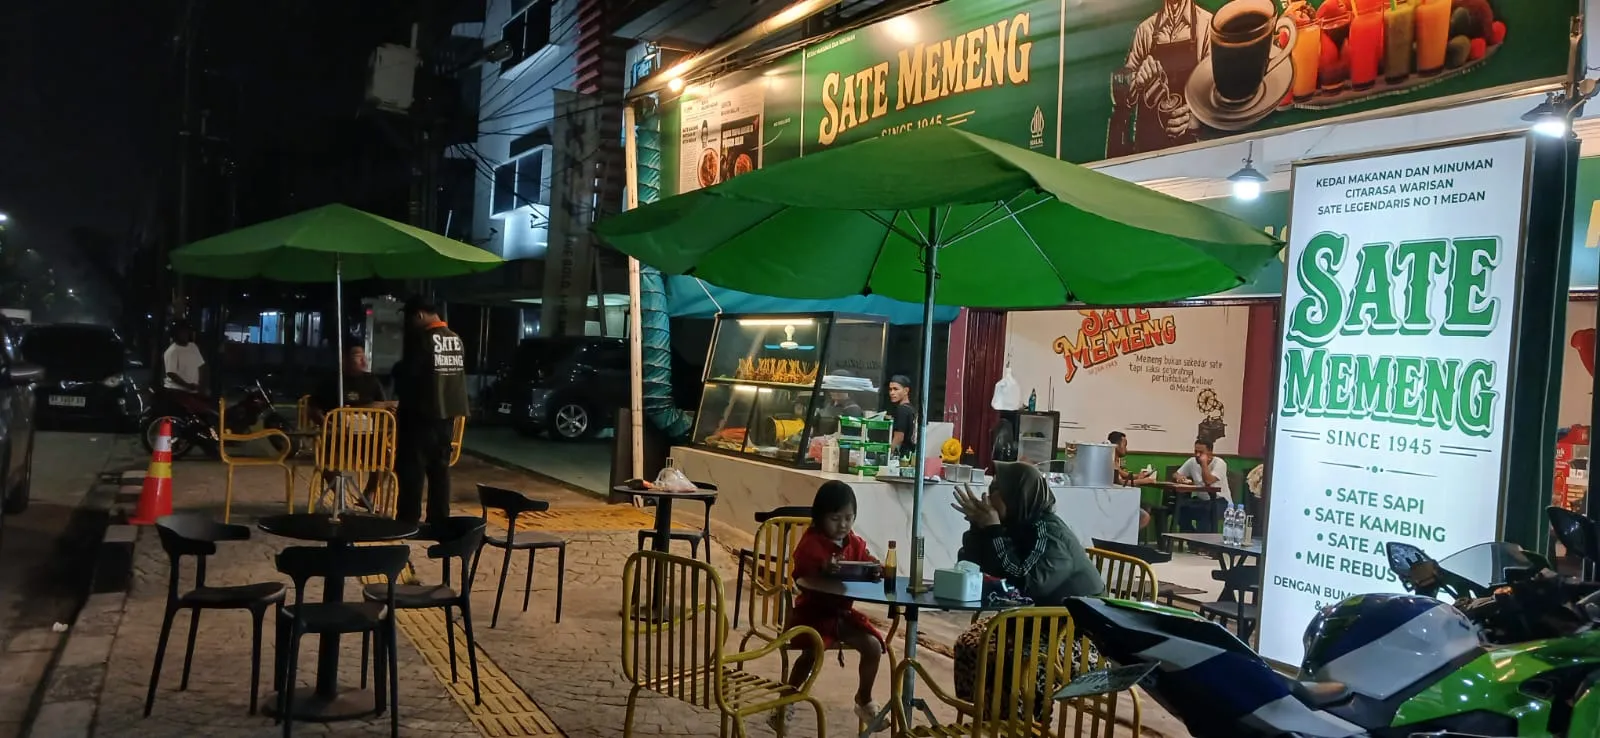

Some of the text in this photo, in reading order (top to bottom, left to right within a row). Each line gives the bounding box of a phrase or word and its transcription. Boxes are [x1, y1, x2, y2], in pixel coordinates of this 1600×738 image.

[818, 13, 1033, 146] SATE MEMENG
[1316, 158, 1494, 188] KEDAI MAKANAN DAN MINUMAN
[1345, 178, 1454, 199] CITARASA WARISAN
[1318, 191, 1486, 215] SATE LEGENDARIS NO 1 MEDAN
[1286, 230, 1502, 349] SATE
[432, 334, 461, 353] SATE
[1052, 315, 1176, 383] MEMENG
[434, 353, 464, 367] MEMENG
[1128, 361, 1143, 374] tapi
[1209, 359, 1223, 369] sate
[1281, 348, 1499, 438] MEMENG
[1326, 429, 1432, 456] SINCE 1945
[1336, 487, 1424, 515] SATE SAPI
[1314, 507, 1446, 543] SATE KAMBING
[1328, 532, 1369, 553] SATE
[1306, 551, 1397, 582] MIE REBUS
[1273, 575, 1321, 595] DENGAN
